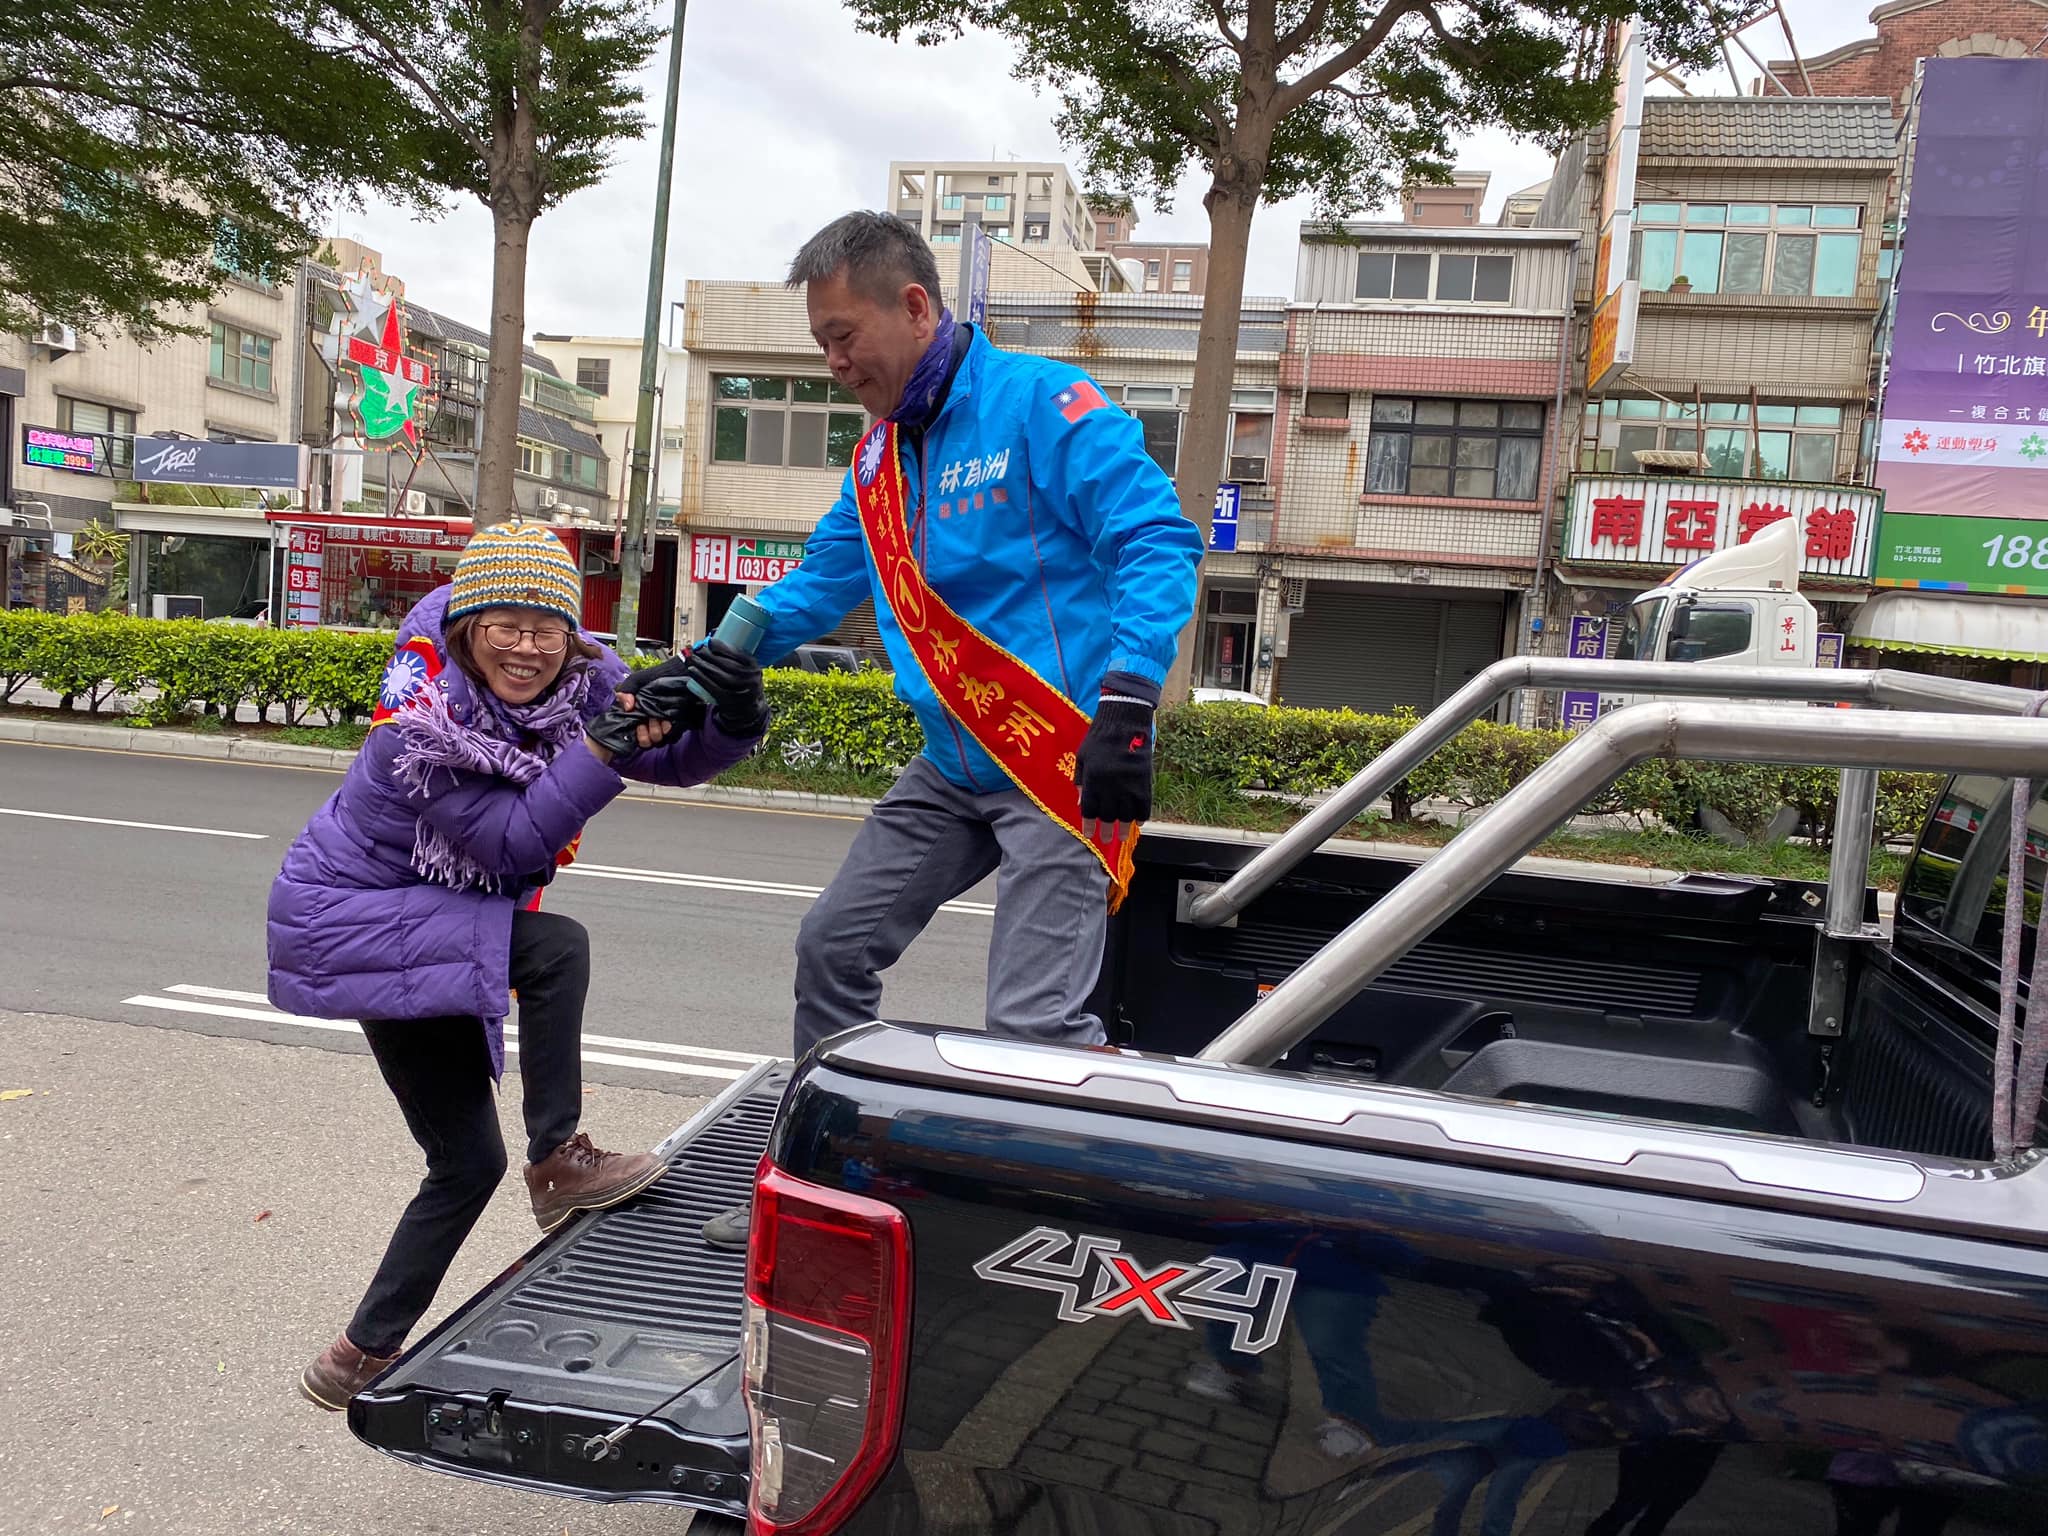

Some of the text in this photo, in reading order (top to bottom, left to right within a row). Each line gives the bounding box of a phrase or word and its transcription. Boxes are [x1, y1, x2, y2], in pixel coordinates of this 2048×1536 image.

[694, 538, 727, 580] 租
[290, 568, 319, 590] 包葉
[1780, 617, 1796, 651] 景山
